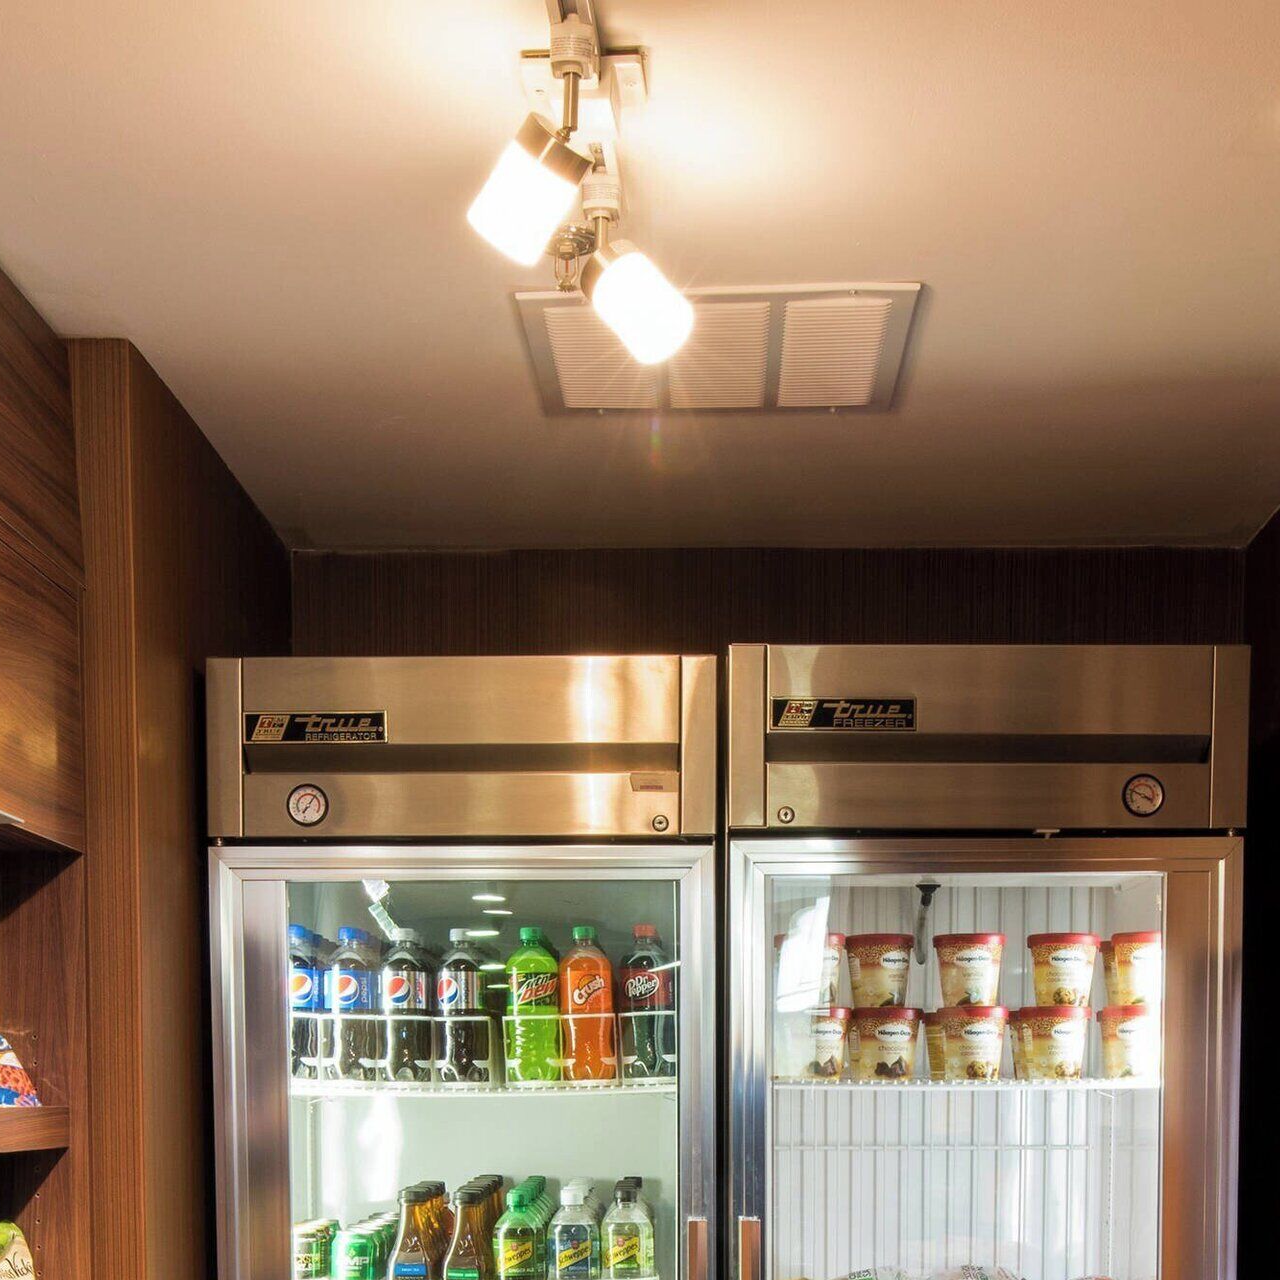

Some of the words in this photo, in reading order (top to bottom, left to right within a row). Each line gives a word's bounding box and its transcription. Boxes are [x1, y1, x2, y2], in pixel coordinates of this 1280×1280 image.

[833, 718, 907, 728] FREEZER
[305, 732, 377, 742] REFRIGERATOR
[636, 974, 650, 986] Dr
[573, 975, 606, 1006] Crush
[626, 979, 658, 998] Pepper
